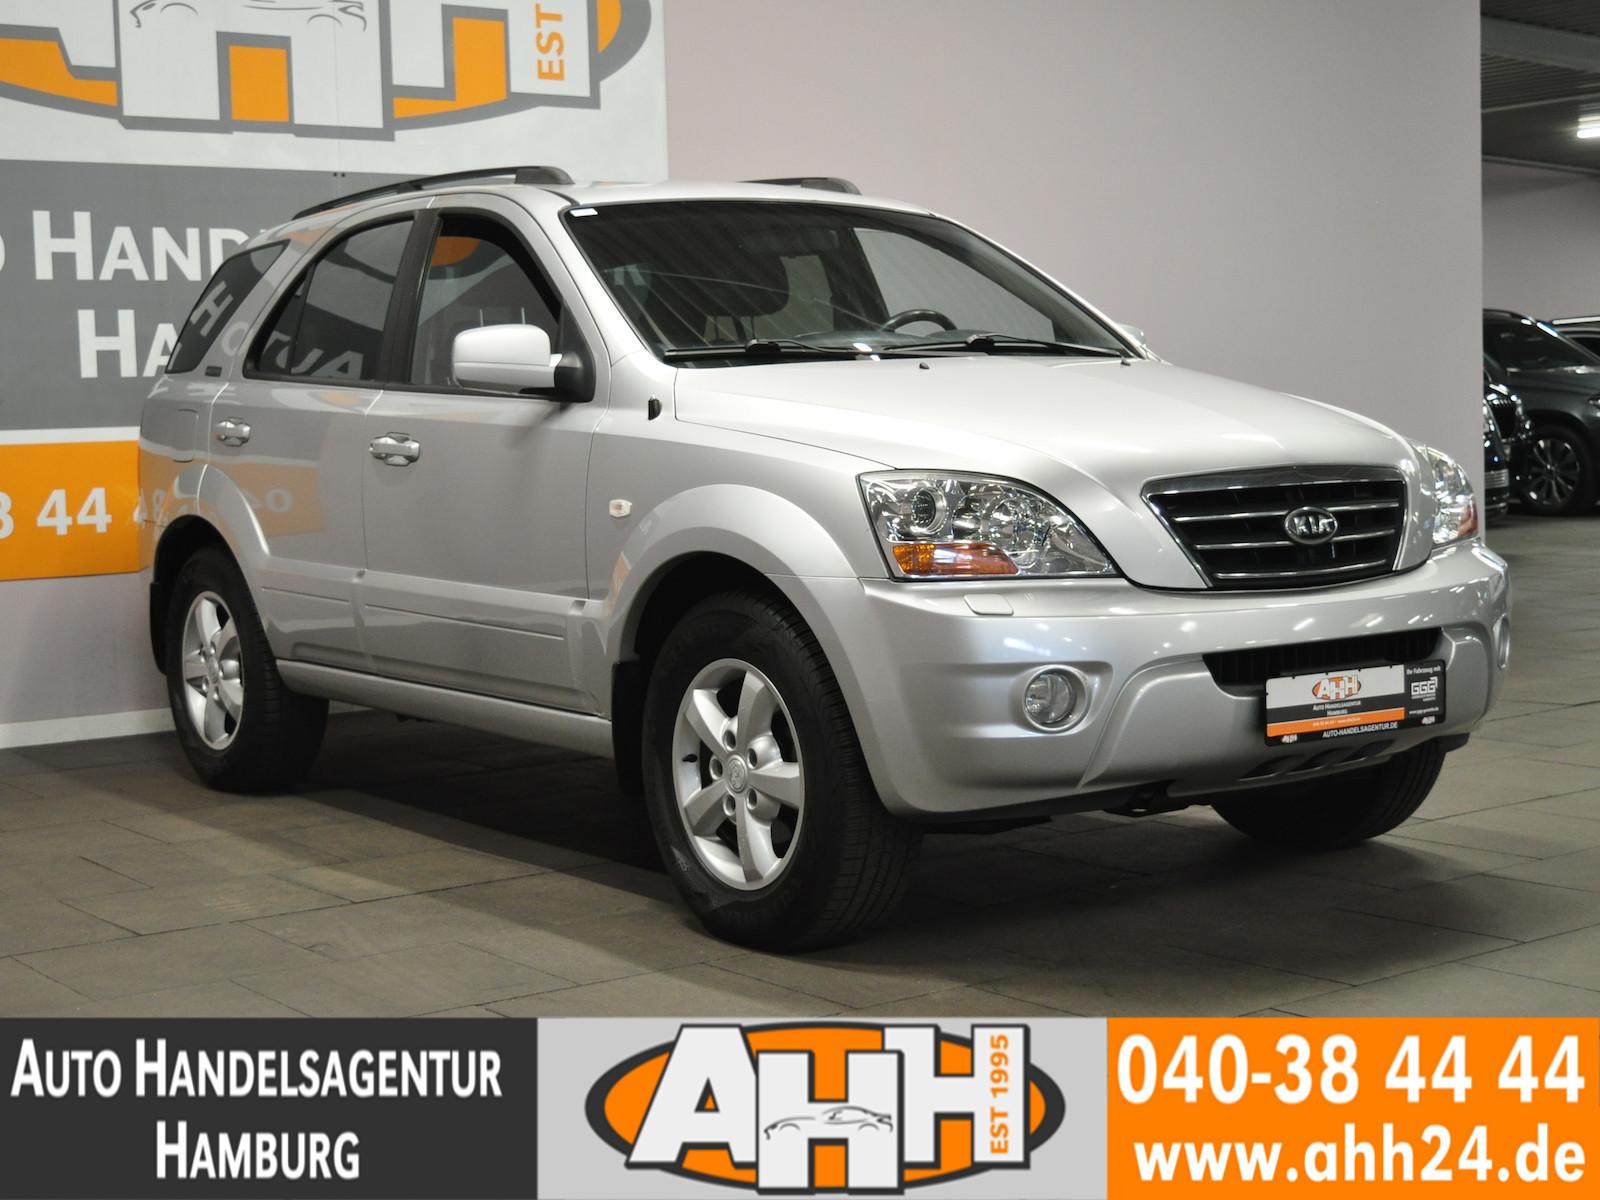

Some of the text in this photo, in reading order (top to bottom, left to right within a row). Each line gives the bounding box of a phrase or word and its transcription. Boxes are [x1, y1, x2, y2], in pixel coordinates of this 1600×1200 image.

[535, 3, 565, 81] EST
[35, 486, 113, 536] 44
[1293, 514, 1334, 536] KIA
[1411, 678, 1438, 696] GGG
